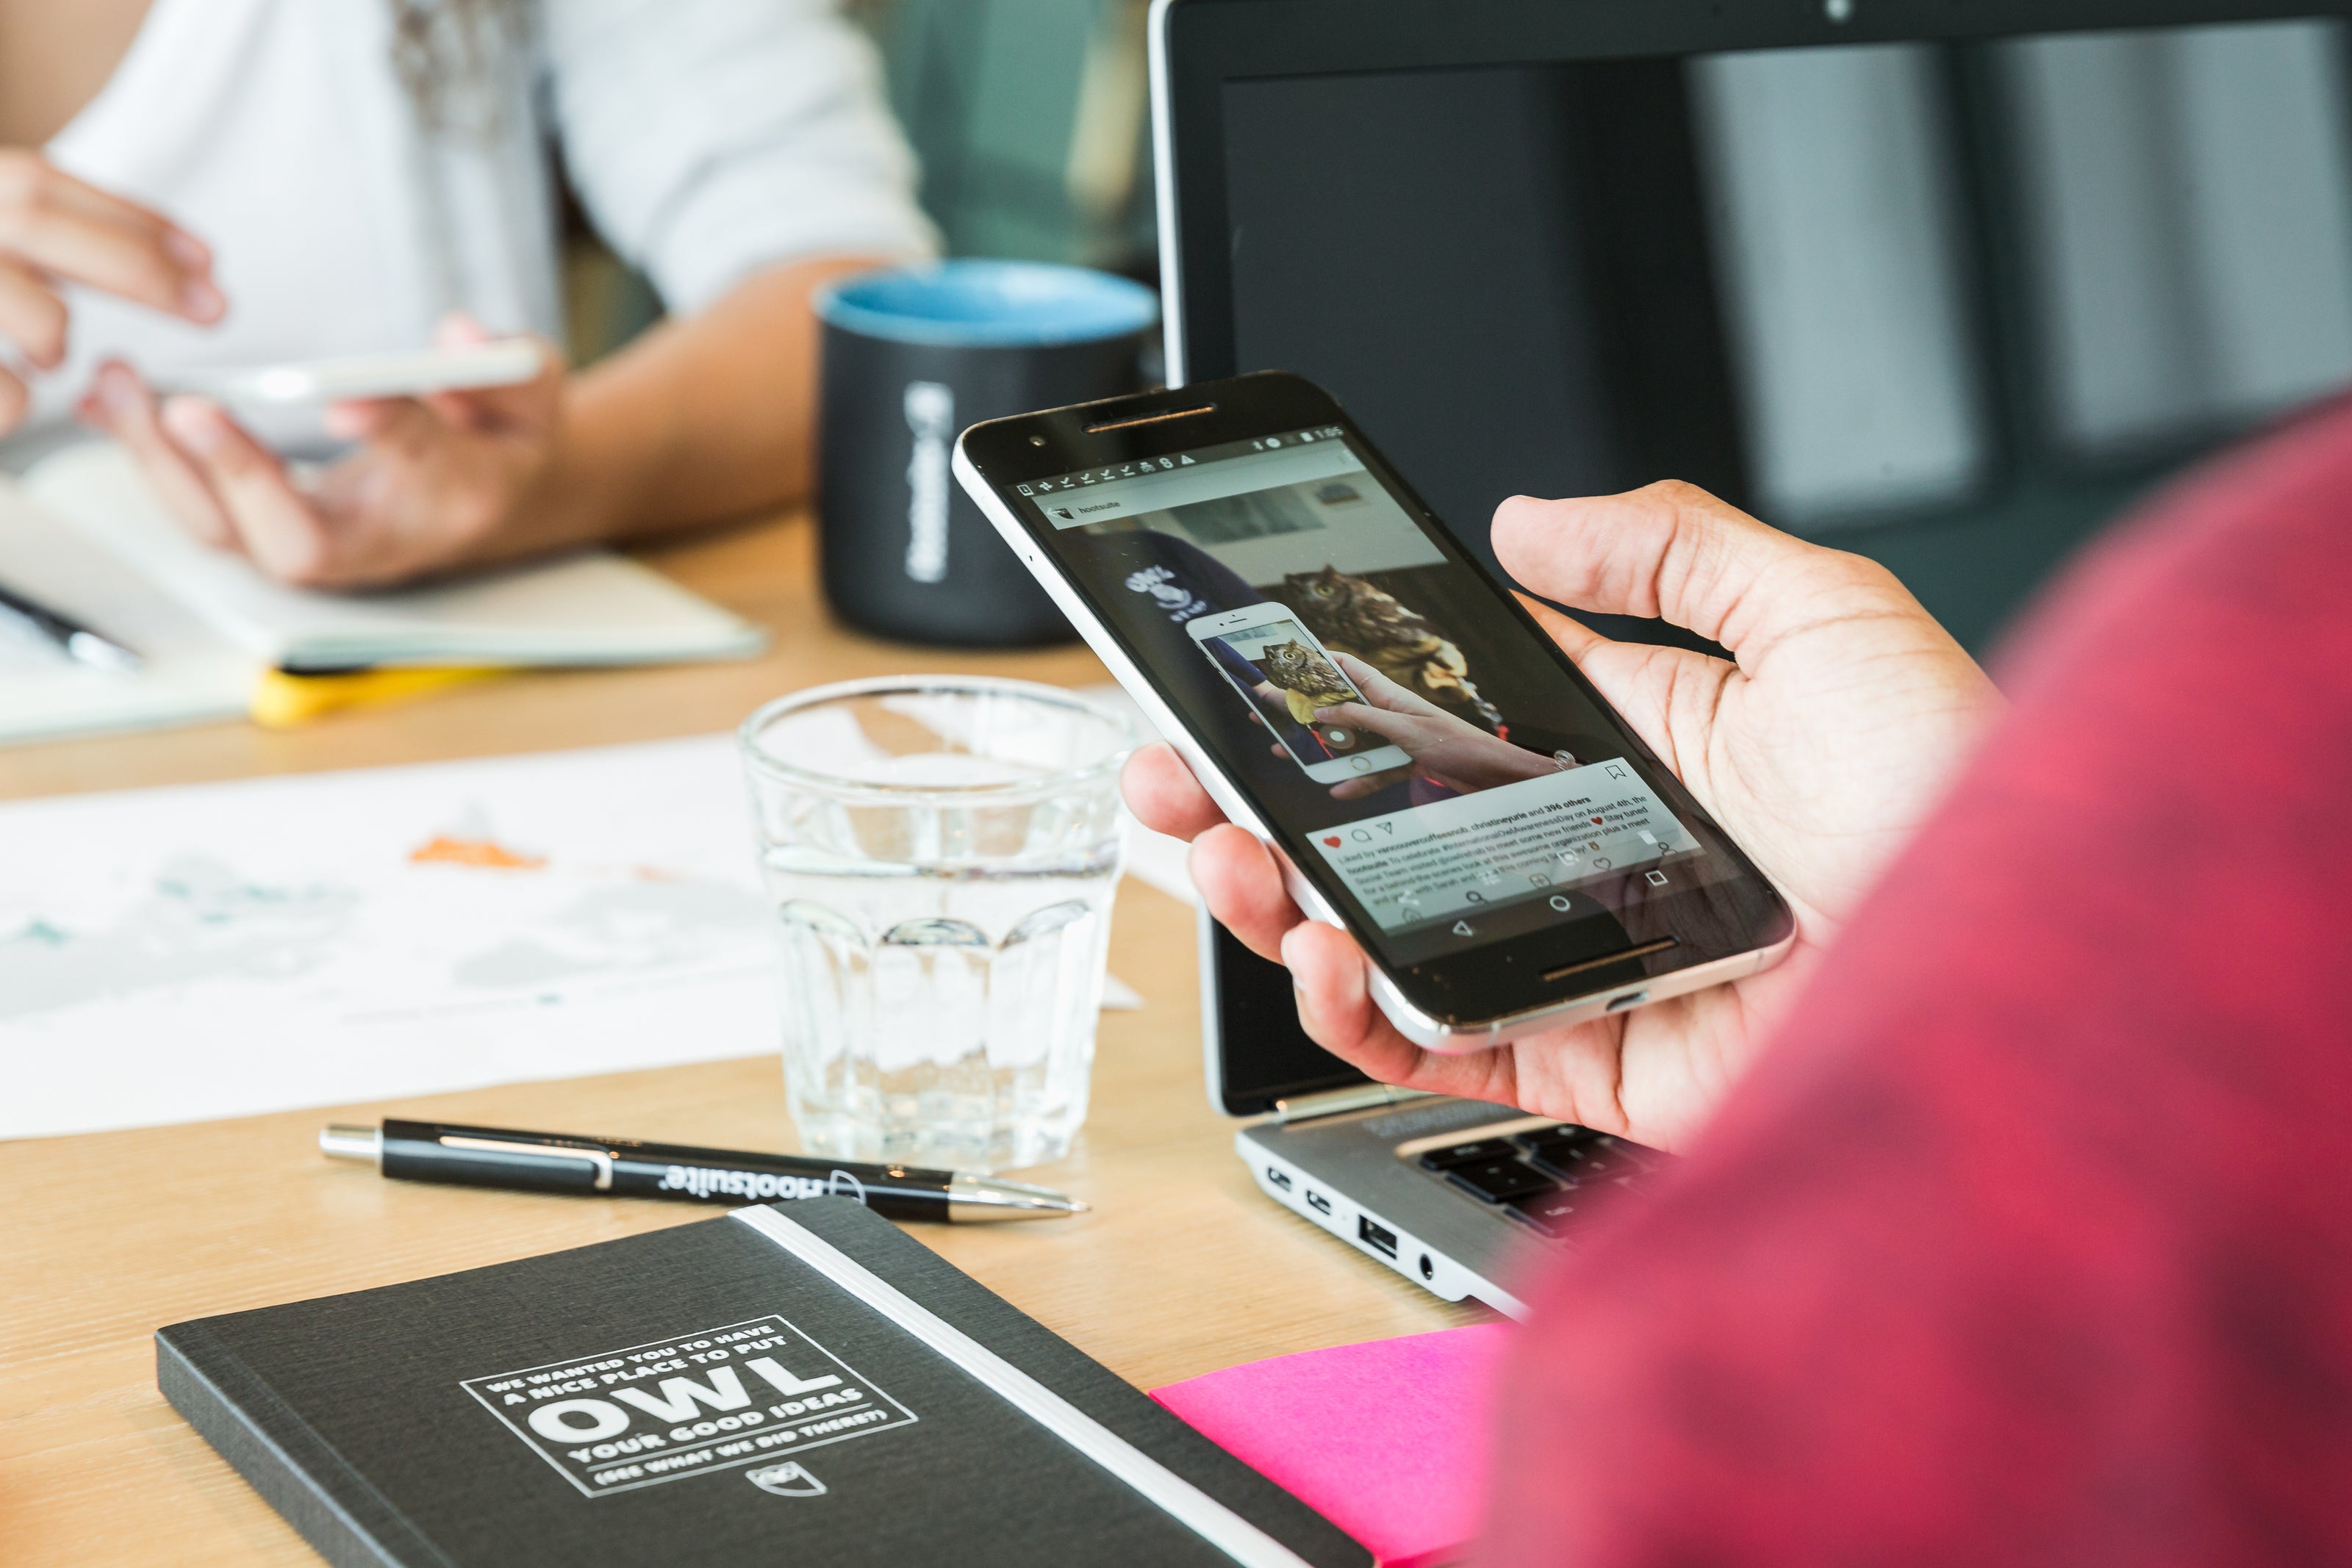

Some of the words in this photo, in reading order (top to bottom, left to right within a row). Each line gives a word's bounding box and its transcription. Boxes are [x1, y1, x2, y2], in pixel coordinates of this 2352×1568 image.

[1078, 501, 1121, 514] hootsuite
[1337, 852, 1362, 863] Liked
[1527, 808, 1544, 816] and
[1544, 803, 1562, 811] 396
[1562, 796, 1591, 807] others
[1495, 839, 1519, 849] meet
[1519, 834, 1543, 843] some
[1544, 829, 1562, 837] new
[1561, 820, 1592, 832] friends
[1605, 813, 1624, 822] Stay
[1623, 806, 1648, 816] tuned
[1585, 803, 1616, 815] August
[1616, 799, 1633, 808] 4th,
[1631, 795, 1647, 803] the
[1363, 886, 1377, 894] for
[1463, 860, 1481, 868] look
[1491, 853, 1510, 861] this
[1510, 844, 1551, 857] awesome
[1550, 830, 1602, 847] organization
[1602, 825, 1621, 835] plus
[1627, 819, 1649, 827] meet
[1413, 885, 1433, 893] with
[1458, 873, 1477, 882] and
[1515, 855, 1549, 868] coming
[486, 1379, 526, 1392] WE
[526, 1359, 624, 1384] WANTED
[626, 1348, 676, 1362] YOU
[678, 1340, 711, 1351] TO
[714, 1326, 775, 1343] HAVE
[504, 1393, 526, 1405] A
[528, 1378, 598, 1399] NICE
[600, 1359, 688, 1384] PLACE
[689, 1350, 729, 1363] TO
[733, 1336, 786, 1354] PUT
[528, 1357, 843, 1443] OWL
[568, 1434, 666, 1462] YOUR
[670, 1411, 764, 1441] GOOD
[769, 1388, 863, 1418] IDEAS
[595, 1465, 643, 1485] (SEE
[644, 1450, 713, 1472] WHAT
[715, 1440, 754, 1456] WE
[756, 1431, 797, 1447] DID
[798, 1409, 887, 1436] THERE?)
